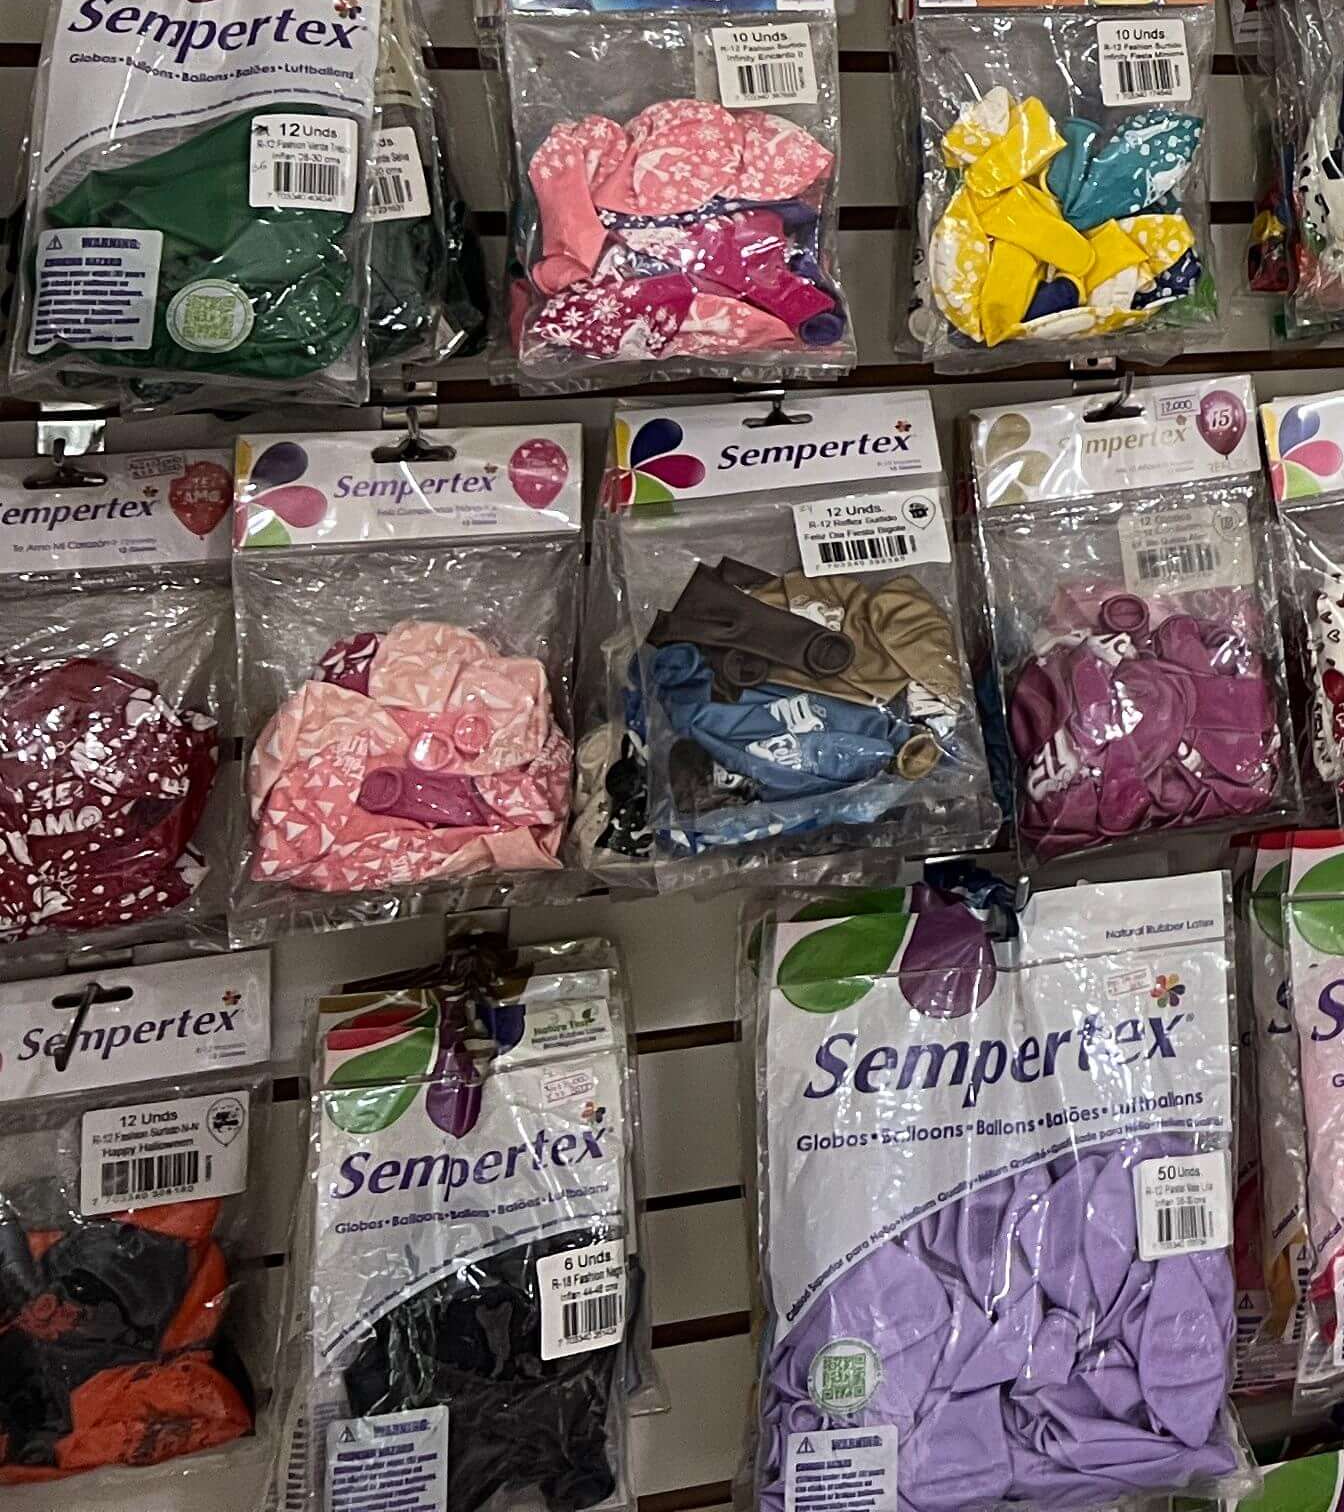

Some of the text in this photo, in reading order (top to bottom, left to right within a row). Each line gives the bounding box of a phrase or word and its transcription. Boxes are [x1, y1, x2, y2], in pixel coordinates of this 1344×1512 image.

[731, 30, 789, 44] 10 Unds
[1114, 27, 1166, 42] 10 Unds
[279, 122, 300, 139] 12
[1211, 408, 1232, 428] 15
[717, 434, 912, 475] Sempertex
[334, 469, 498, 502] Sempertex
[826, 506, 842, 519] 12
[17, 1008, 240, 1065] Sempertex
[803, 1013, 1194, 1109] Sempertex
[119, 1110, 178, 1128] 12 Unds
[796, 1131, 869, 1153] Globos
[976, 1113, 1036, 1137] Ballons
[329, 1126, 609, 1202] Sempertex
[1156, 1164, 1177, 1182] 50
[335, 1220, 384, 1235] Globos
[564, 1256, 575, 1270] 6
